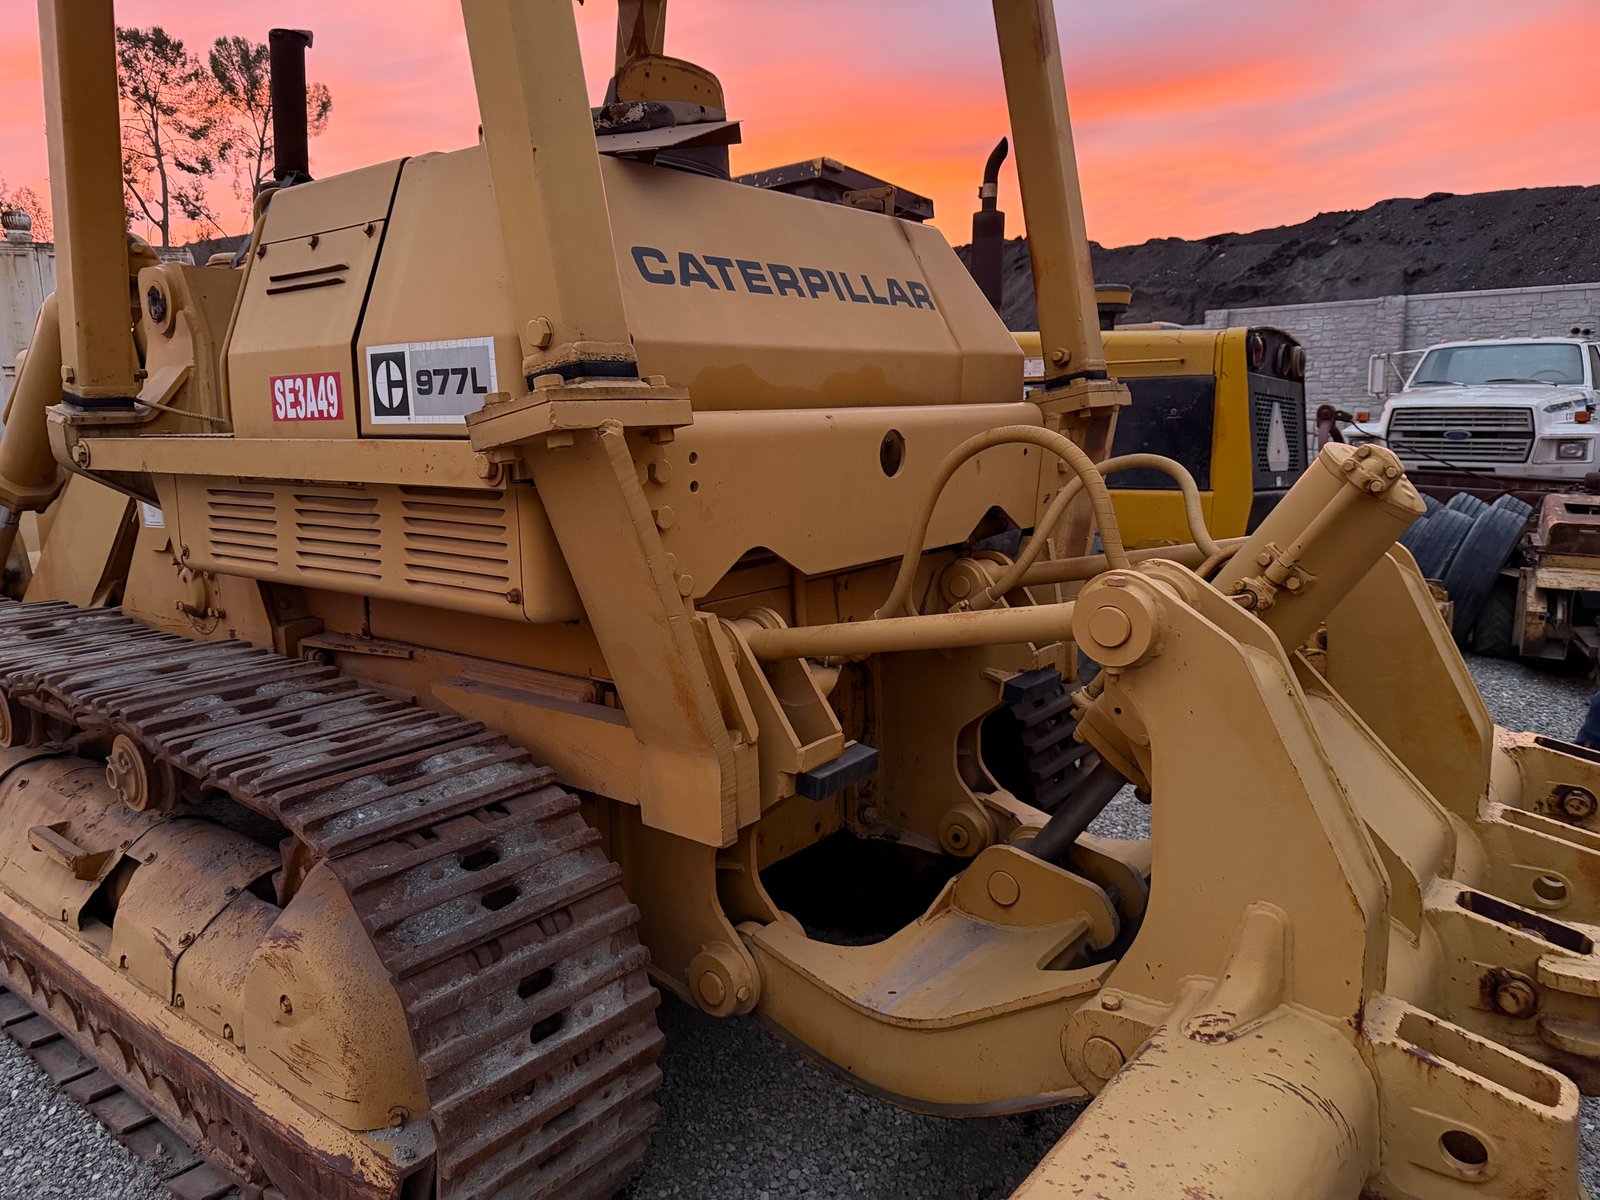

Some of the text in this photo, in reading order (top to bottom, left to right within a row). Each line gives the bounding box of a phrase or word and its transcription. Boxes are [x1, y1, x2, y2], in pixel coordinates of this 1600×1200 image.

[630, 245, 936, 310] CATERPILLAR
[274, 375, 339, 419] SE3A49
[415, 366, 488, 395] 977L
